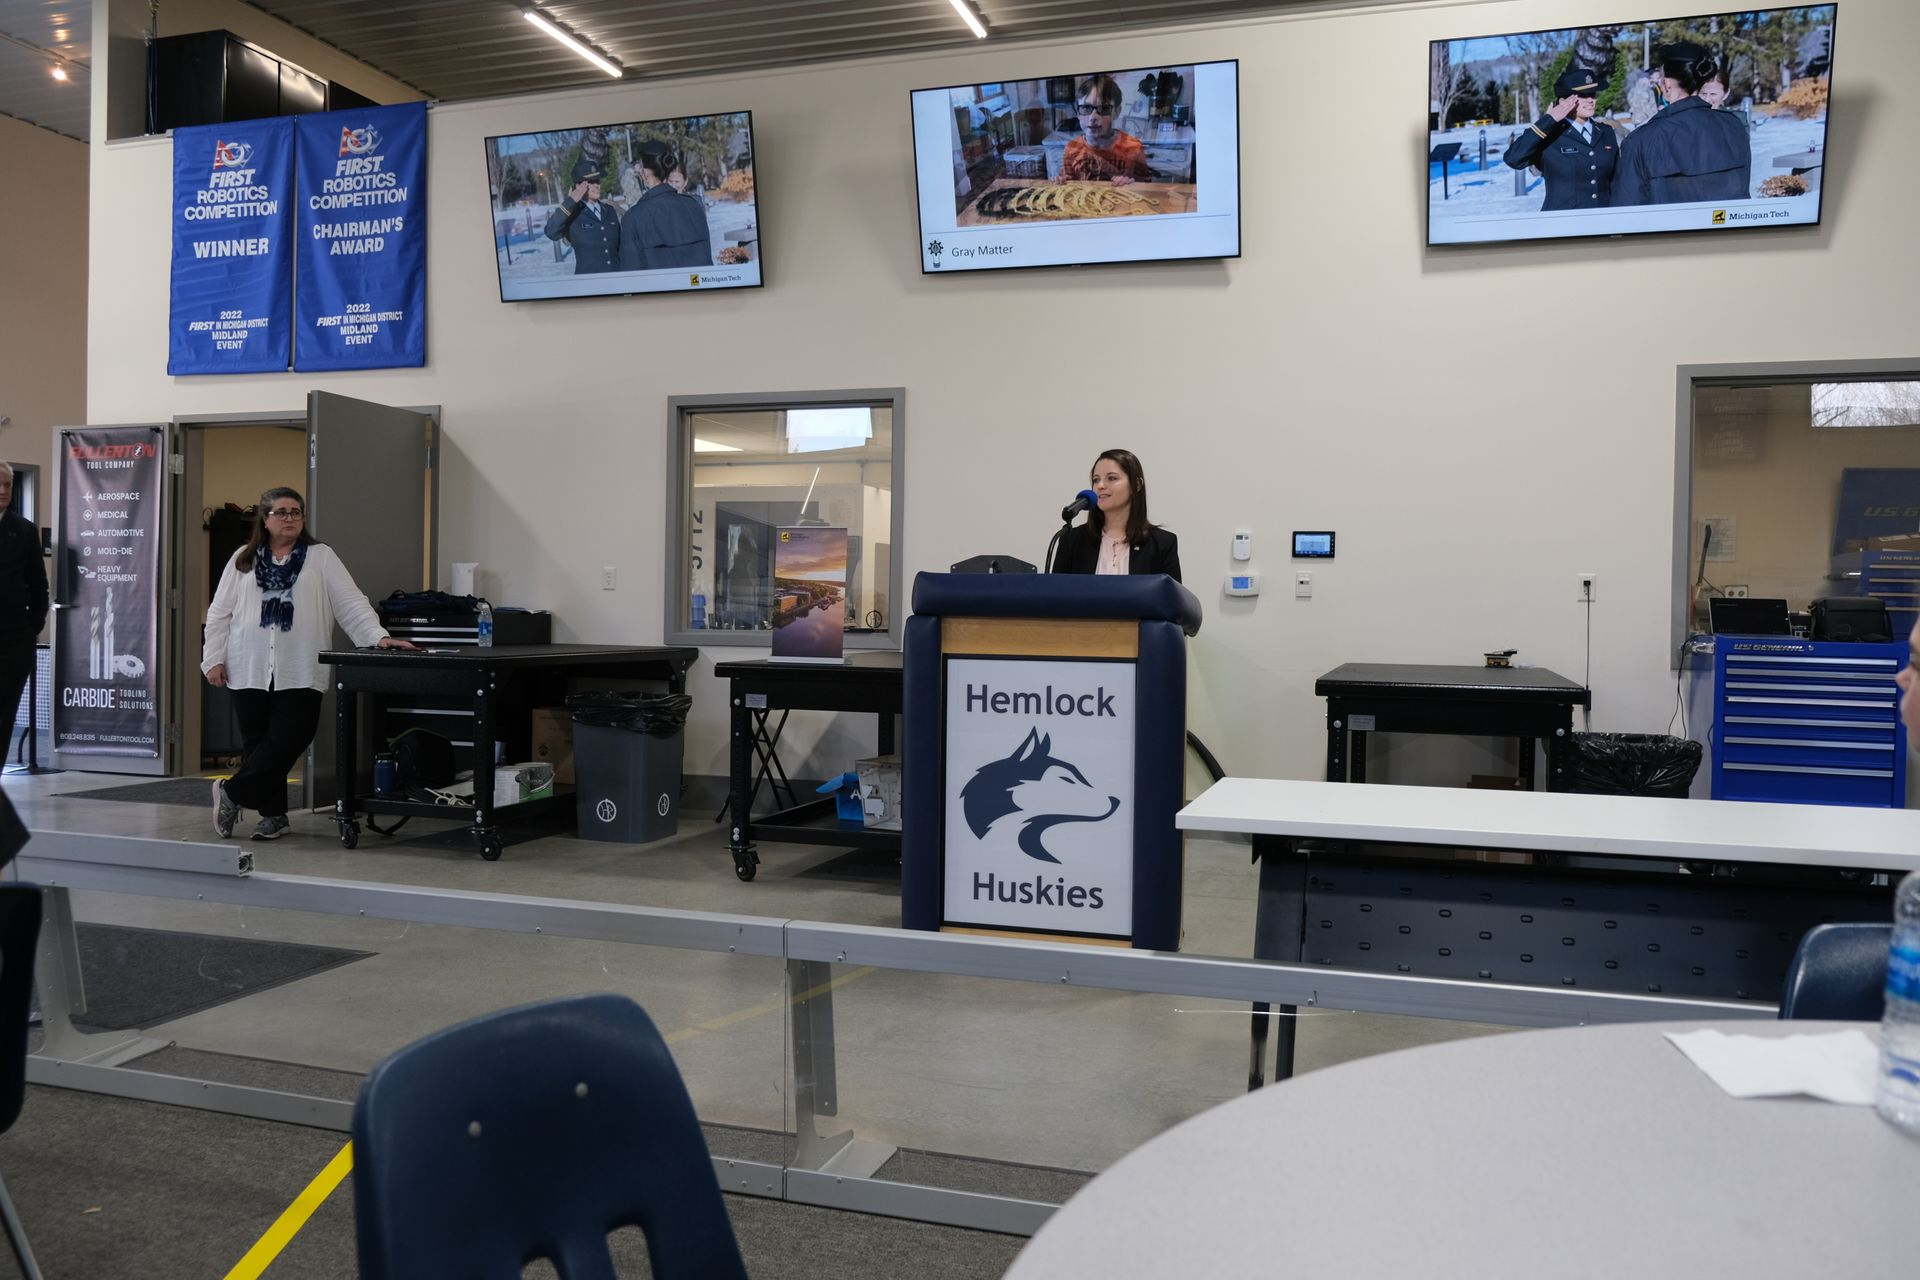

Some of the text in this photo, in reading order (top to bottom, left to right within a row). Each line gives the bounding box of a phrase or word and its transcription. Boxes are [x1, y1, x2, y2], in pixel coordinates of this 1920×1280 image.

[335, 156, 385, 177] FIRST
[209, 169, 256, 188] FIRST
[323, 172, 397, 193] ROBOTICS
[197, 185, 268, 204] ROBOTICS
[309, 187, 408, 210] COMPETITION
[184, 200, 278, 221] COMPETITION
[1729, 210, 1790, 220] Michigan Tech
[313, 216, 404, 240] CHAIRMAN'S
[193, 237, 269, 259] WINNER
[330, 237, 385, 256] AWARD
[951, 245, 1014, 258] Gray Matter
[346, 303, 371, 313] 2022
[220, 310, 243, 320] 2022
[316, 311, 403, 327] FIRST IN MICHIGAN DISTRICT
[188, 318, 269, 331] FIRST IN MICHIGAN DISTRICT
[340, 324, 379, 335] MIDLAND
[212, 330, 248, 340] MIDLAND
[345, 335, 373, 345] EVENT
[216, 340, 243, 350] EVENT
[87, 460, 135, 469] TOOL COMPANY
[97, 492, 140, 501] AEROSPACE
[97, 511, 128, 519] MEDICAL
[97, 529, 144, 537] AUTOMOTIVE
[97, 547, 133, 555] MOLD-DIE
[97, 574, 137, 582] EQUIPMENT
[63, 687, 116, 709] CARBIDE
[119, 689, 147, 698] TOOLING
[119, 701, 153, 710] SOLUTIONS
[966, 683, 1117, 718] Hemlock
[99, 735, 155, 744] FULLERTONTOOL.COM
[973, 871, 1104, 910] Huskies
